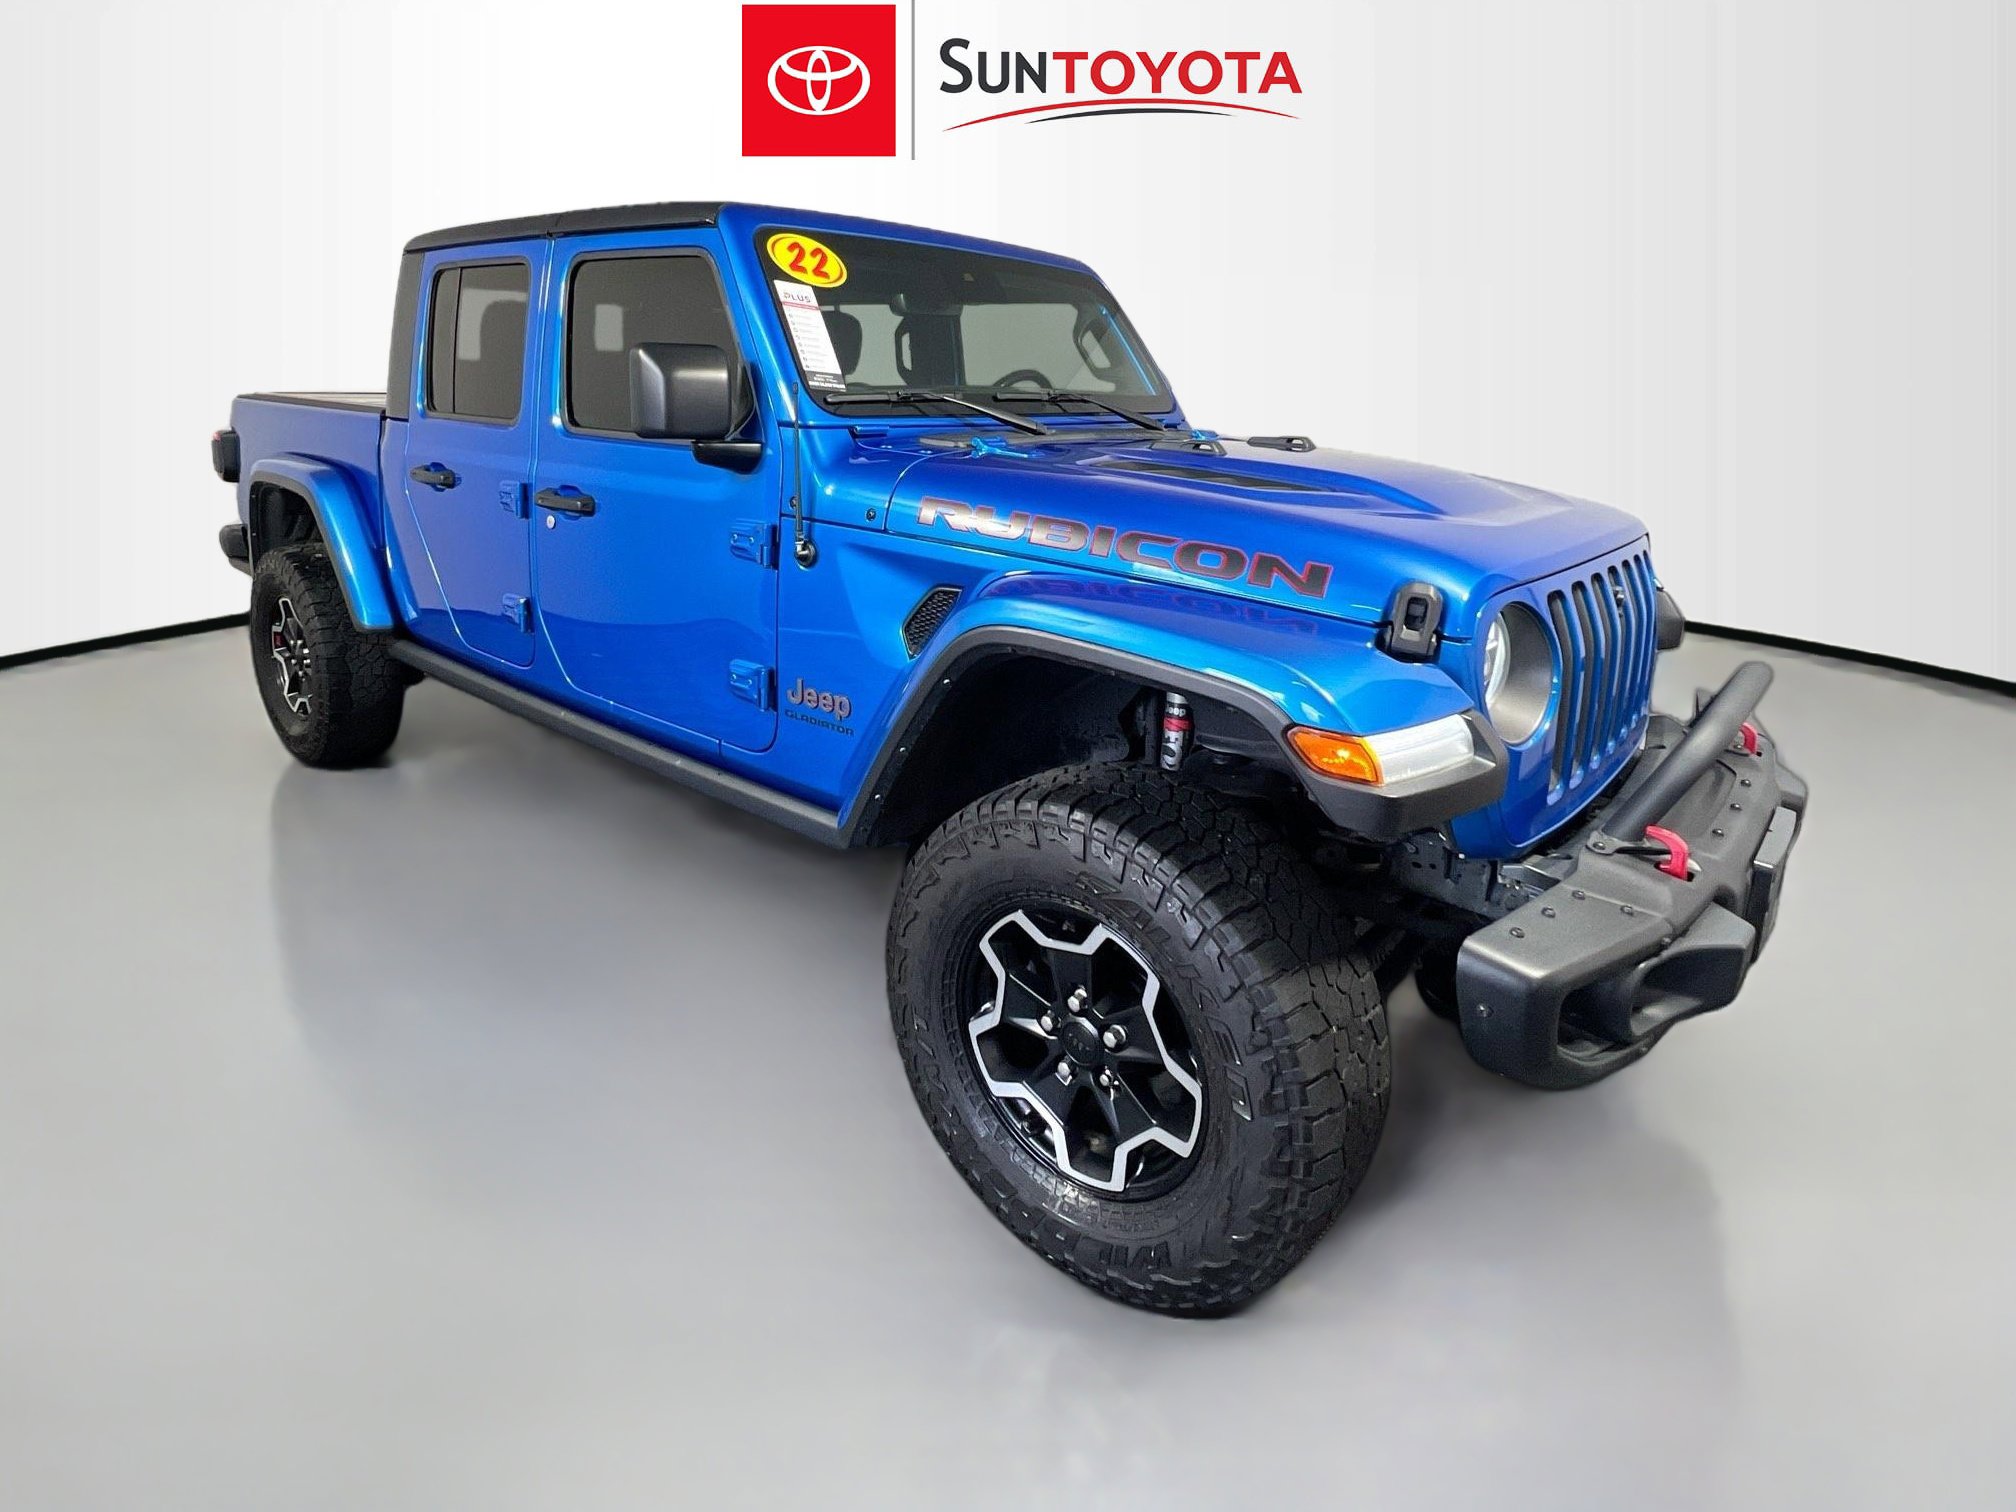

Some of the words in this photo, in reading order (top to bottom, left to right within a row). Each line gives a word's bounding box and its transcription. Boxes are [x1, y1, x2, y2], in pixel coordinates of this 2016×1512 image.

[786, 241, 831, 280] 22
[783, 292, 811, 303] PLUS
[916, 496, 1333, 600] RUBICON
[786, 677, 852, 721] Jeep
[784, 709, 855, 737] GLADIATOR
